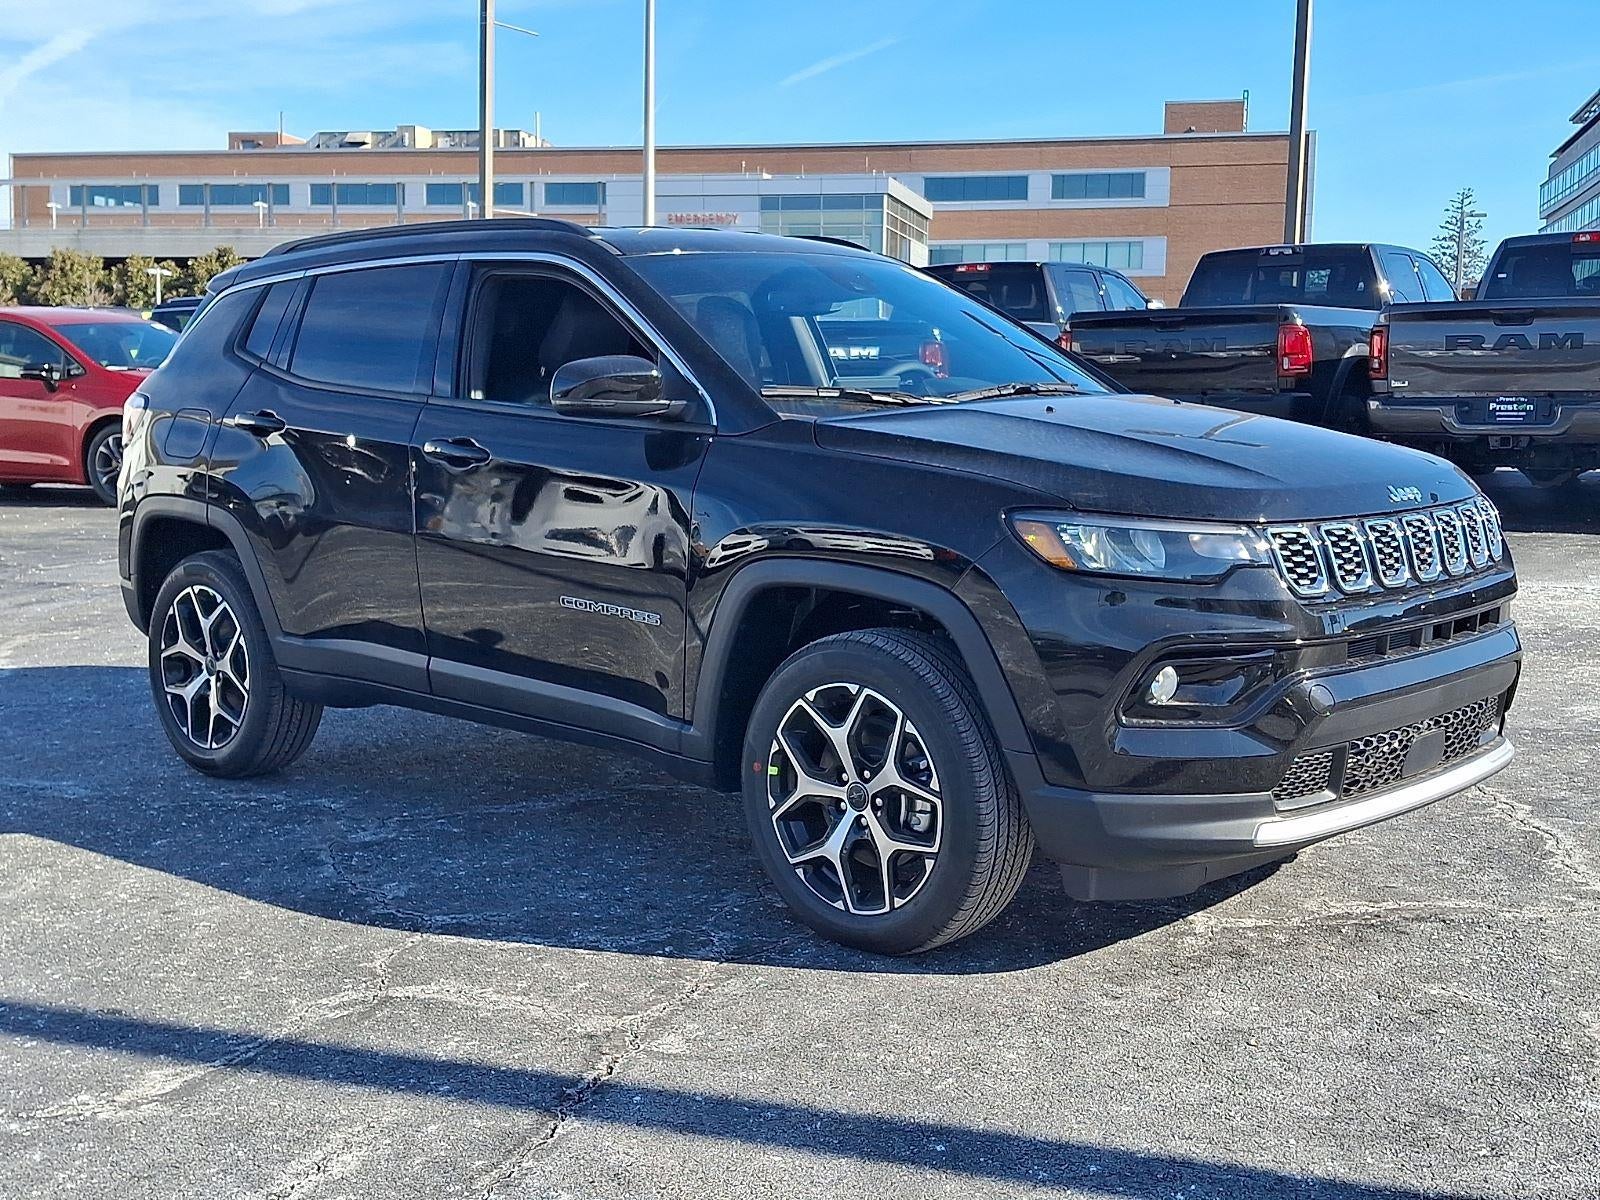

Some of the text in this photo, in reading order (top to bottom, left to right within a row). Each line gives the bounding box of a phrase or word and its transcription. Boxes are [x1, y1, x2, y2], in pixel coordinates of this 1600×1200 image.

[667, 213, 739, 225] EMERGENCY
[1114, 337, 1227, 353] RAM
[1444, 332, 1585, 351] RAM
[828, 346, 880, 360] AM
[1489, 402, 1534, 411] Preston
[1386, 485, 1422, 504] Jeep
[560, 595, 661, 626] COMPASS
